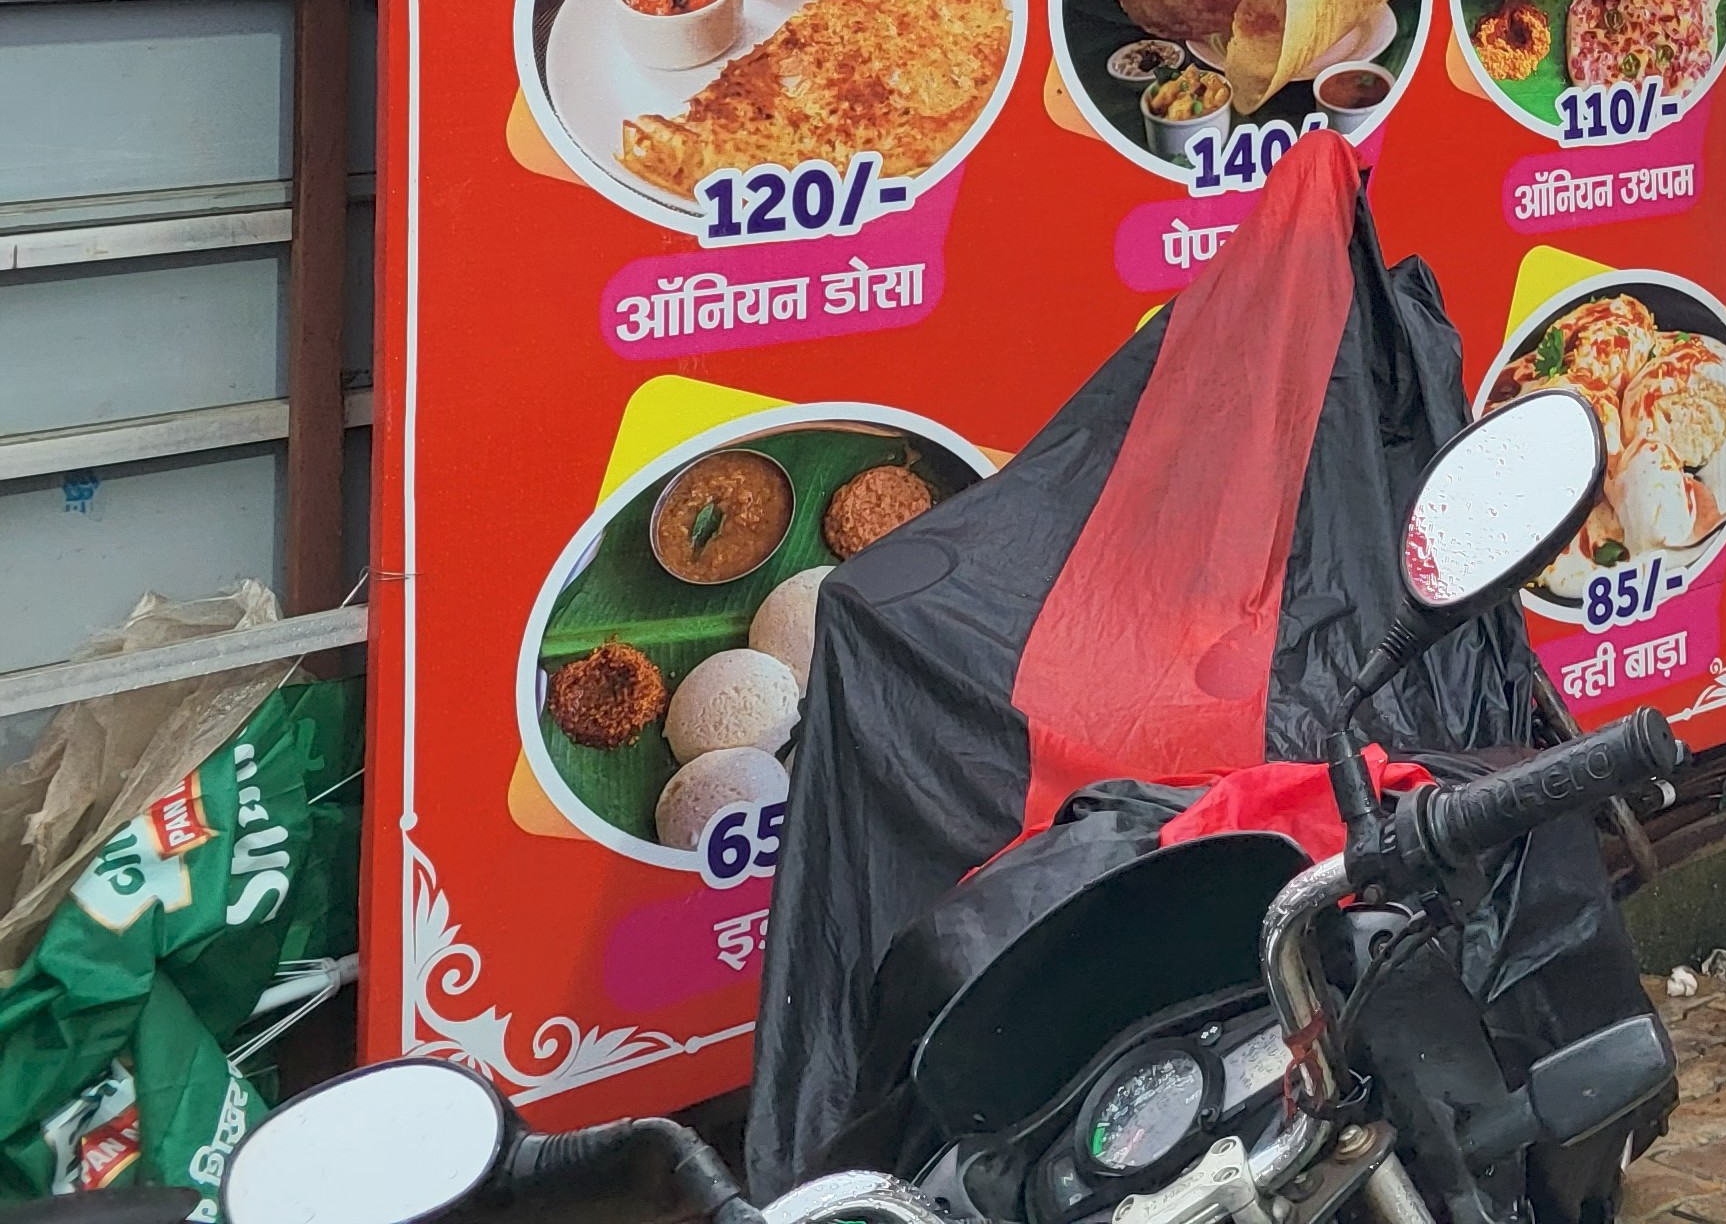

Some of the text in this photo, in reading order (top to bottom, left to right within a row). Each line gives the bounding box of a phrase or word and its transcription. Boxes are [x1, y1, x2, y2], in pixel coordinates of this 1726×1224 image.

[1560, 82, 1678, 141] 110/-
[1191, 121, 1321, 189] 140
[704, 160, 907, 239] 120/-
[1514, 164, 1695, 220] ऑनियन उथपम
[1162, 218, 1239, 269] पेप
[616, 256, 926, 342] ऑनियन डोसा
[1587, 557, 1683, 625] 85/-
[1561, 631, 1688, 699] दही बाड़ा
[162, 797, 196, 848] PAN
